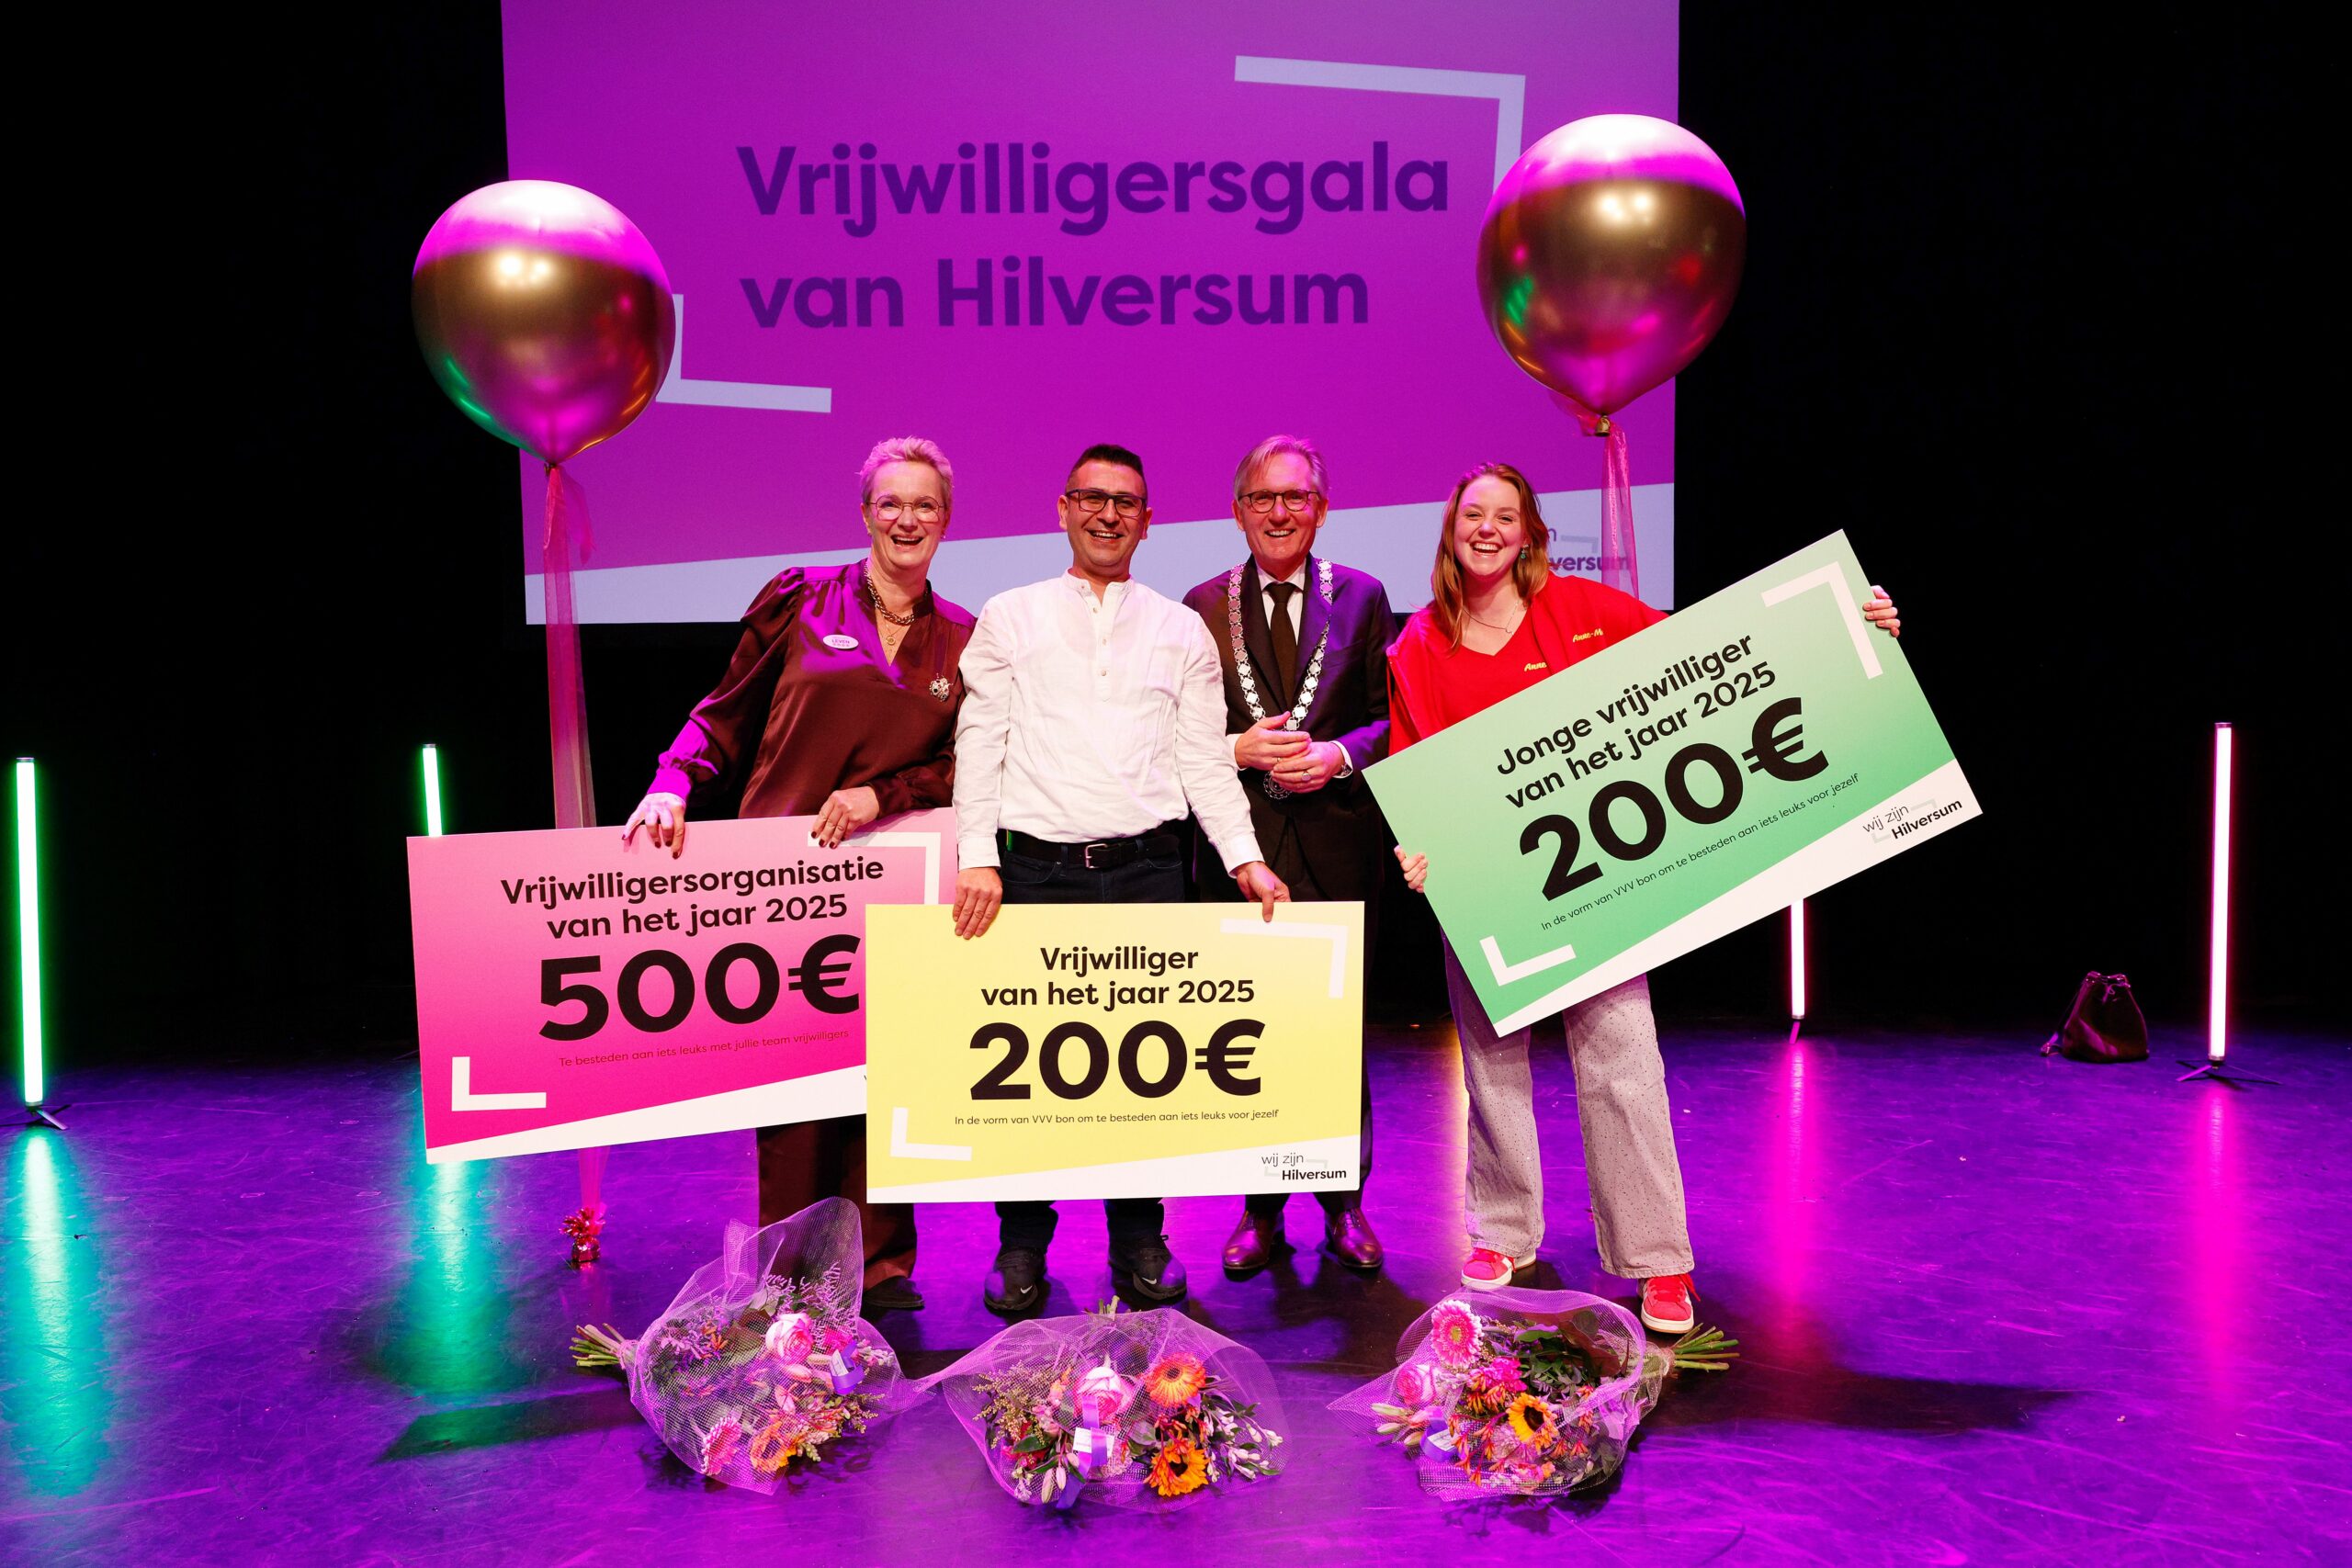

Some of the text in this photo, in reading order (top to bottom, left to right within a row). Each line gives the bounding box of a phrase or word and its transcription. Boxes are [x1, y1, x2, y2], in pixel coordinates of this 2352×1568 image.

[736, 141, 1449, 238] Vrijwilligersgala
[740, 255, 1369, 329] van Hilversum
[1549, 556, 1630, 571] versum
[1498, 635, 1751, 775] Jonge vrijwilliger
[1506, 661, 1776, 808] van het jaar 2025
[1520, 697, 1828, 901] 200€
[1862, 806, 1909, 831] wij zijn
[1891, 800, 1963, 840] Hilversum
[1541, 773, 1859, 931] In de vorm van VVV bon om te besteden aan iets leuks voor jezelf
[501, 856, 884, 910] Vrijwilligersorganisatie
[548, 894, 848, 940] van het jaar 2025
[1040, 946, 1198, 977] Vrijwilliger
[539, 934, 861, 1041] 500€
[981, 980, 1254, 1012] van het jaar 2025
[560, 1030, 849, 1066] Te besteden aan iets leuks met jullie team vrijwilligers
[970, 1019, 1265, 1100] 200€
[955, 1116, 965, 1125] In
[967, 1116, 980, 1124] de
[1032, 1115, 1053, 1123] VVV
[1056, 1114, 1074, 1123] bon
[1096, 1114, 1107, 1122] te
[1110, 1112, 1157, 1122] besteden
[1182, 1111, 1199, 1121] iets
[1202, 1111, 1227, 1120] leuks
[1250, 1110, 1280, 1121] jezelf
[1261, 1152, 1304, 1168] wij zijn
[1282, 1169, 1347, 1180] Hilversum
